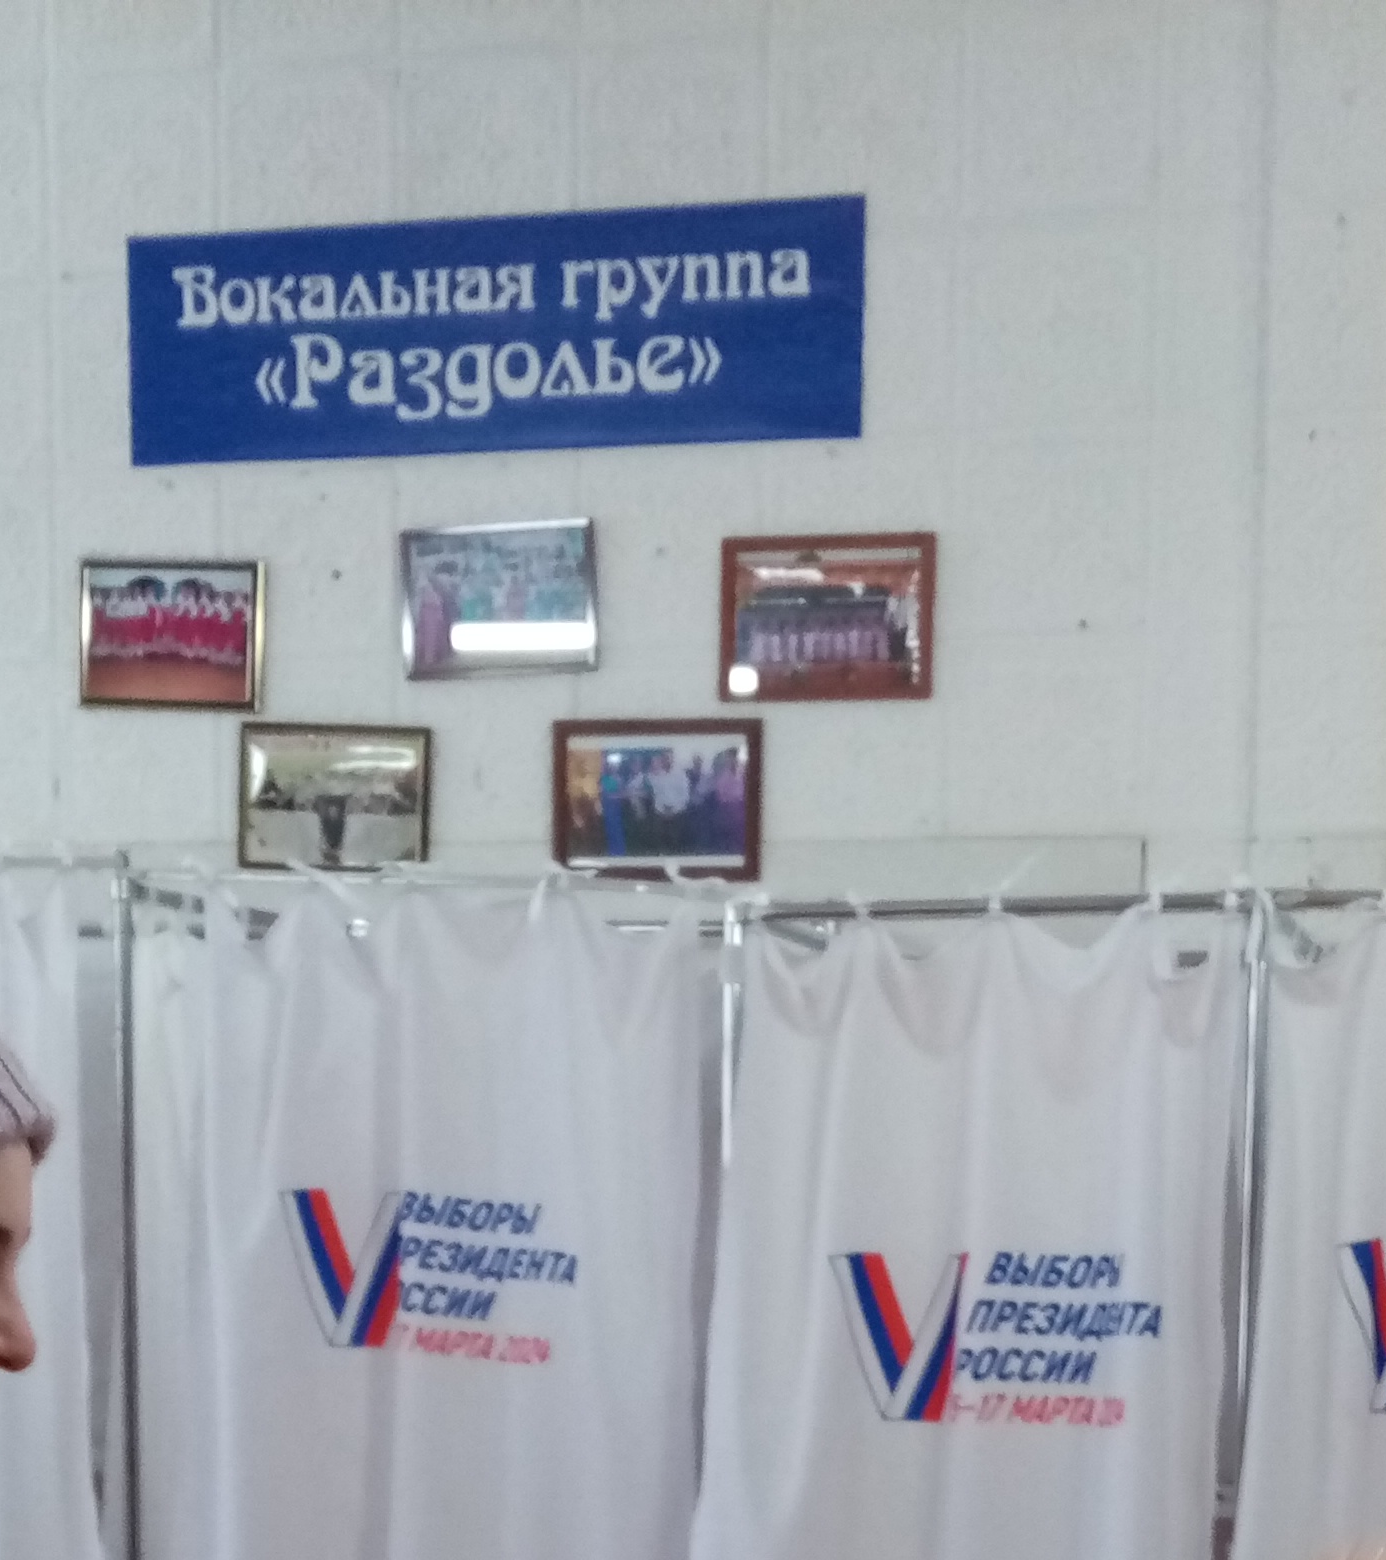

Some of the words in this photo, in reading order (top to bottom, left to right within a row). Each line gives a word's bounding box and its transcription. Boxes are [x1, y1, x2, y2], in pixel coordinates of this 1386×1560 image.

[173, 263, 535, 329] Вокальная
[561, 249, 811, 321] группа
[255, 332, 722, 420] «Раздолье»
[399, 1237, 578, 1287] РЕЗИДЕНТА
